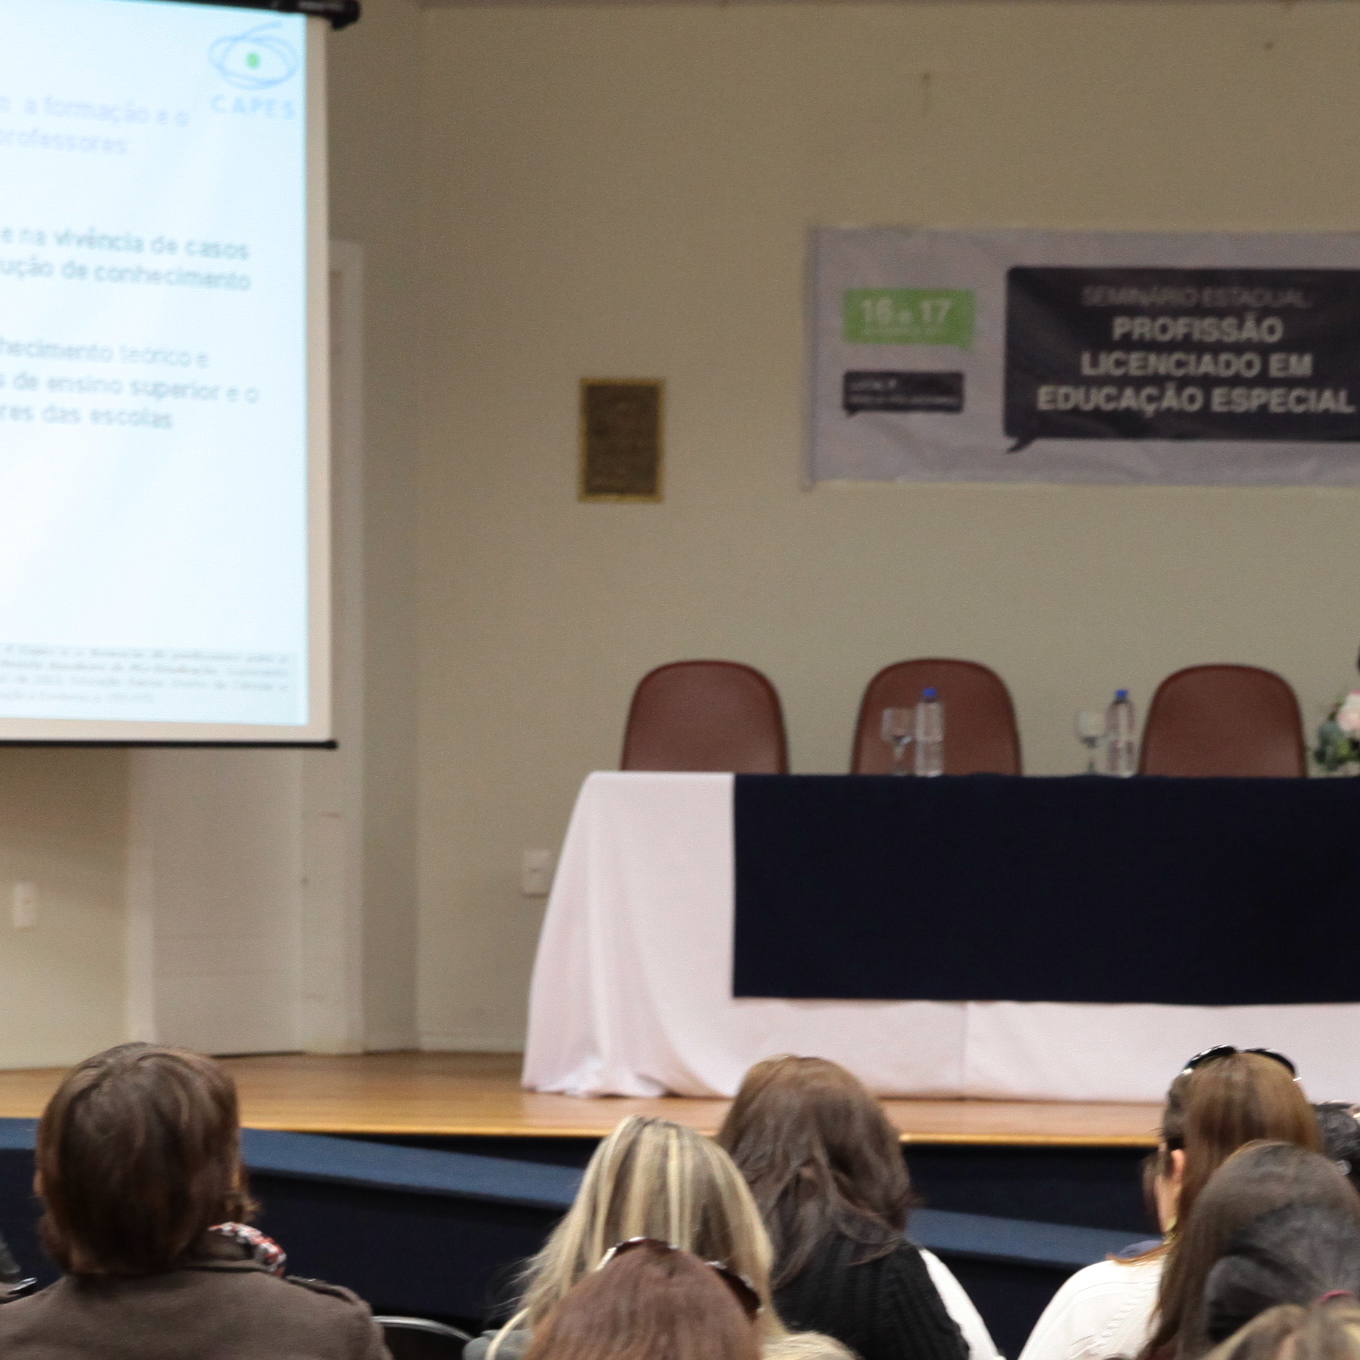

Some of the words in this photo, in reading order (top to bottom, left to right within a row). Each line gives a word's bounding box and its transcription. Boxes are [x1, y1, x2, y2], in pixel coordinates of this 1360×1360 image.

[919, 298, 952, 323] 17
[1112, 312, 1285, 342] PROFISSÃO
[1081, 351, 1262, 377] LICENCIADO
[1267, 353, 1314, 378] EM
[1036, 381, 1205, 418] EDUCAÇÃO
[1209, 386, 1358, 413] ESPECIAL
